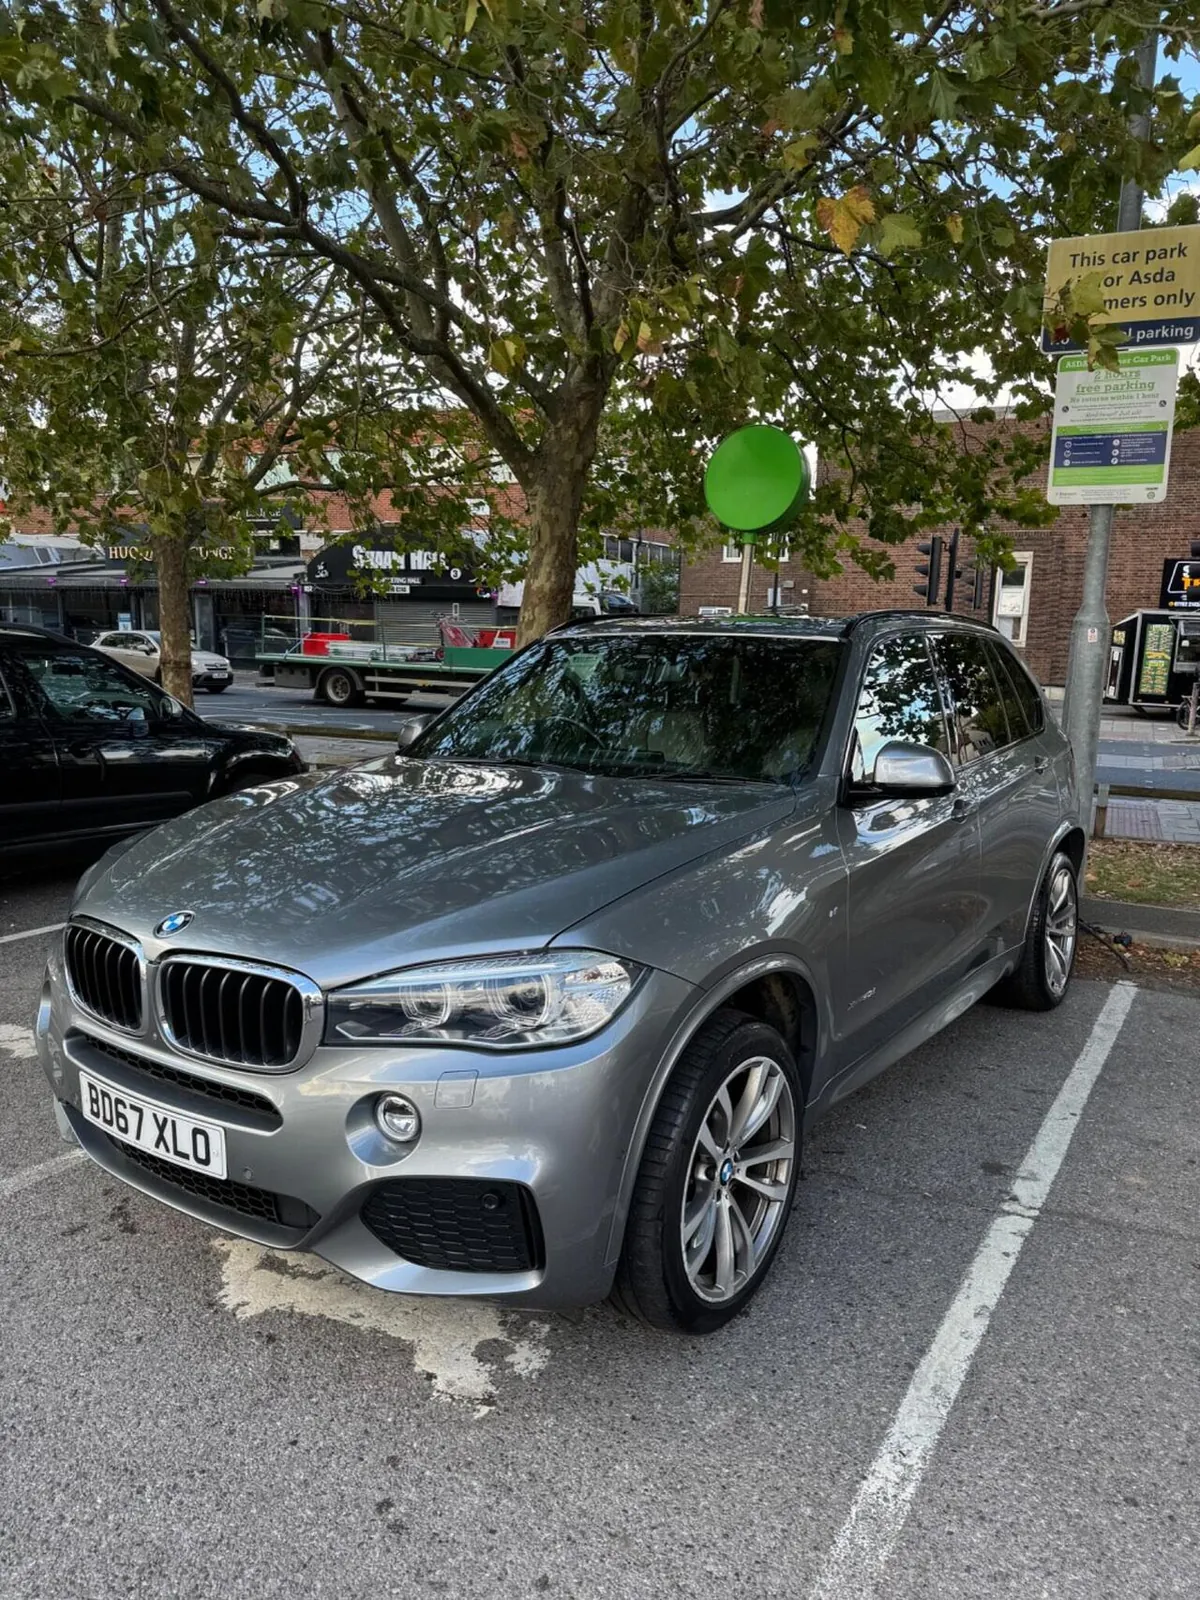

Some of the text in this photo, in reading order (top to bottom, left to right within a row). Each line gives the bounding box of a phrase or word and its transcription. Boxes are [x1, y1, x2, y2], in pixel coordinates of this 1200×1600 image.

[1069, 242, 1188, 268] This car park
[1098, 274, 1123, 288] or
[1128, 267, 1175, 286] Asda
[1153, 288, 1196, 308] only
[1136, 325, 1194, 342] parking
[1150, 353, 1171, 362] Park
[1094, 369, 1141, 380] 2 hours
[1076, 380, 1156, 394] free parking
[87, 1080, 211, 1167] BD67 XLO
